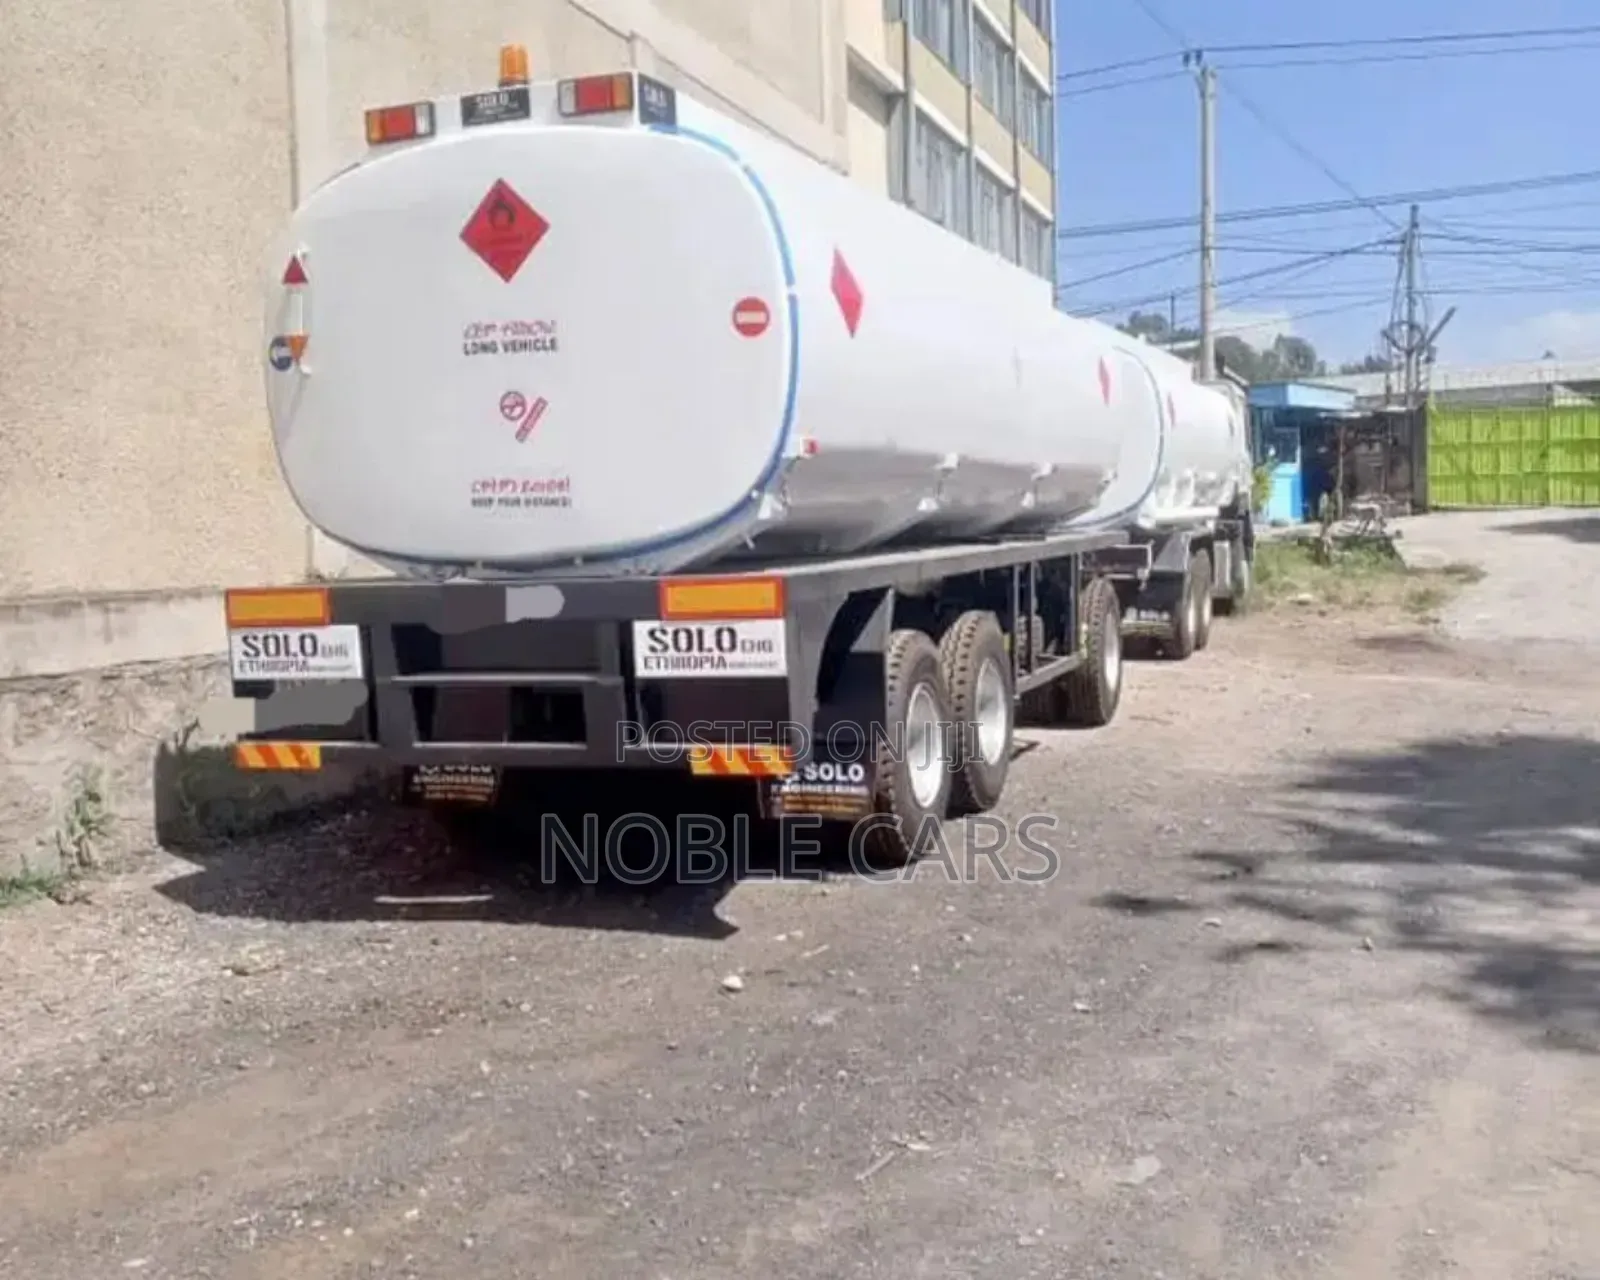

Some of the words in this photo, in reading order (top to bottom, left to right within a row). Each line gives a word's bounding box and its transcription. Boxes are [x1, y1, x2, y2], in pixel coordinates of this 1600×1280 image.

[463, 340, 498, 356] LONG
[502, 337, 557, 353] VEHICLE
[241, 632, 318, 658] SOLO
[647, 626, 738, 654] SOLO
[643, 655, 728, 671] ETHIOPIA
[803, 762, 865, 782] SOLO
